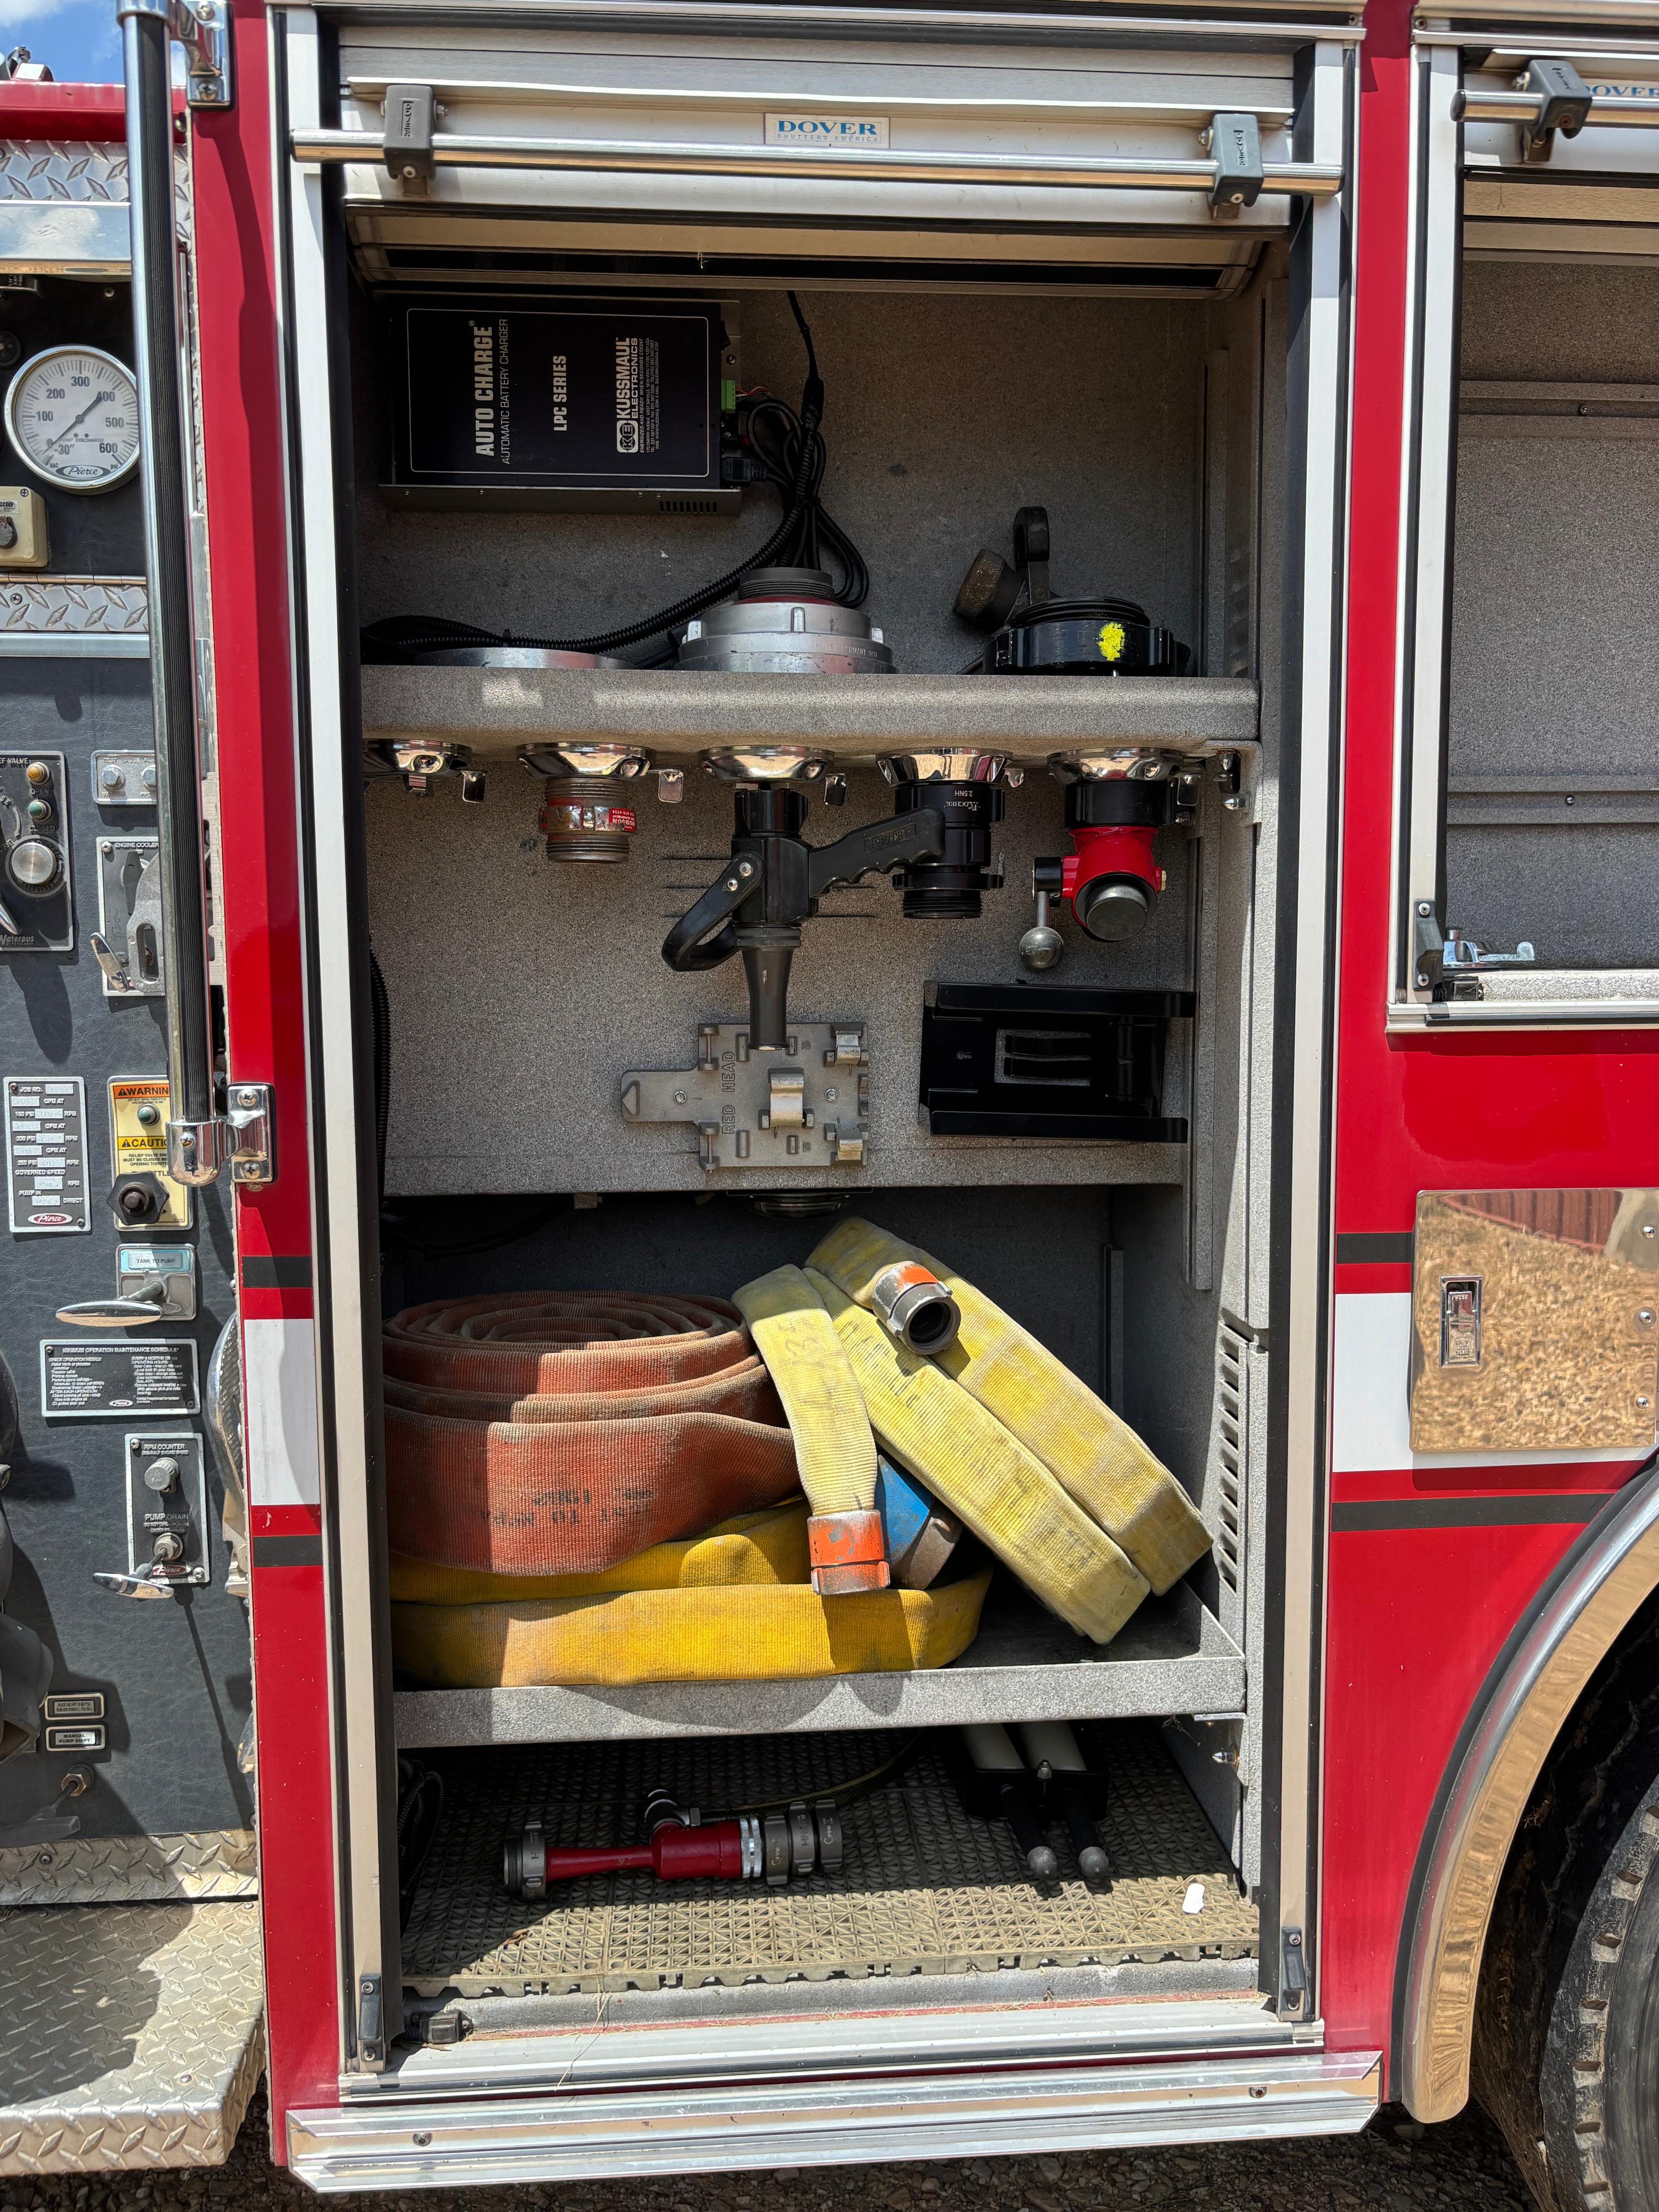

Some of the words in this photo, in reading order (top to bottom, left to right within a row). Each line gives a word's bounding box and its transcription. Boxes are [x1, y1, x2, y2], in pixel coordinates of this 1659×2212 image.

[1584, 85, 1659, 97] OVER
[778, 120, 877, 135] DOVER
[499, 319, 509, 364] CHARGER
[473, 327, 494, 401] CHARGE
[71, 376, 90, 387] 300
[553, 356, 567, 403] SERIES
[615, 338, 630, 419] KUSSMAUL
[46, 388, 65, 399] 200
[499, 367, 509, 408] BATTERY
[97, 391, 115, 402] 400
[36, 411, 54, 421] 100
[106, 417, 124, 427] 500
[554, 407, 567, 431] LPC
[476, 408, 494, 457] AUTO
[500, 411, 510, 465] AUTOMATIC
[99, 443, 118, 453] 600
[68, 467, 98, 476] Pierce
[612, 818, 635, 827] HUDSON
[721, 1051, 736, 1093] HEAD
[126, 1087, 169, 1095] WARNIN
[721, 1104, 736, 1134] RED
[156, 1565, 181, 1574] Pierce
